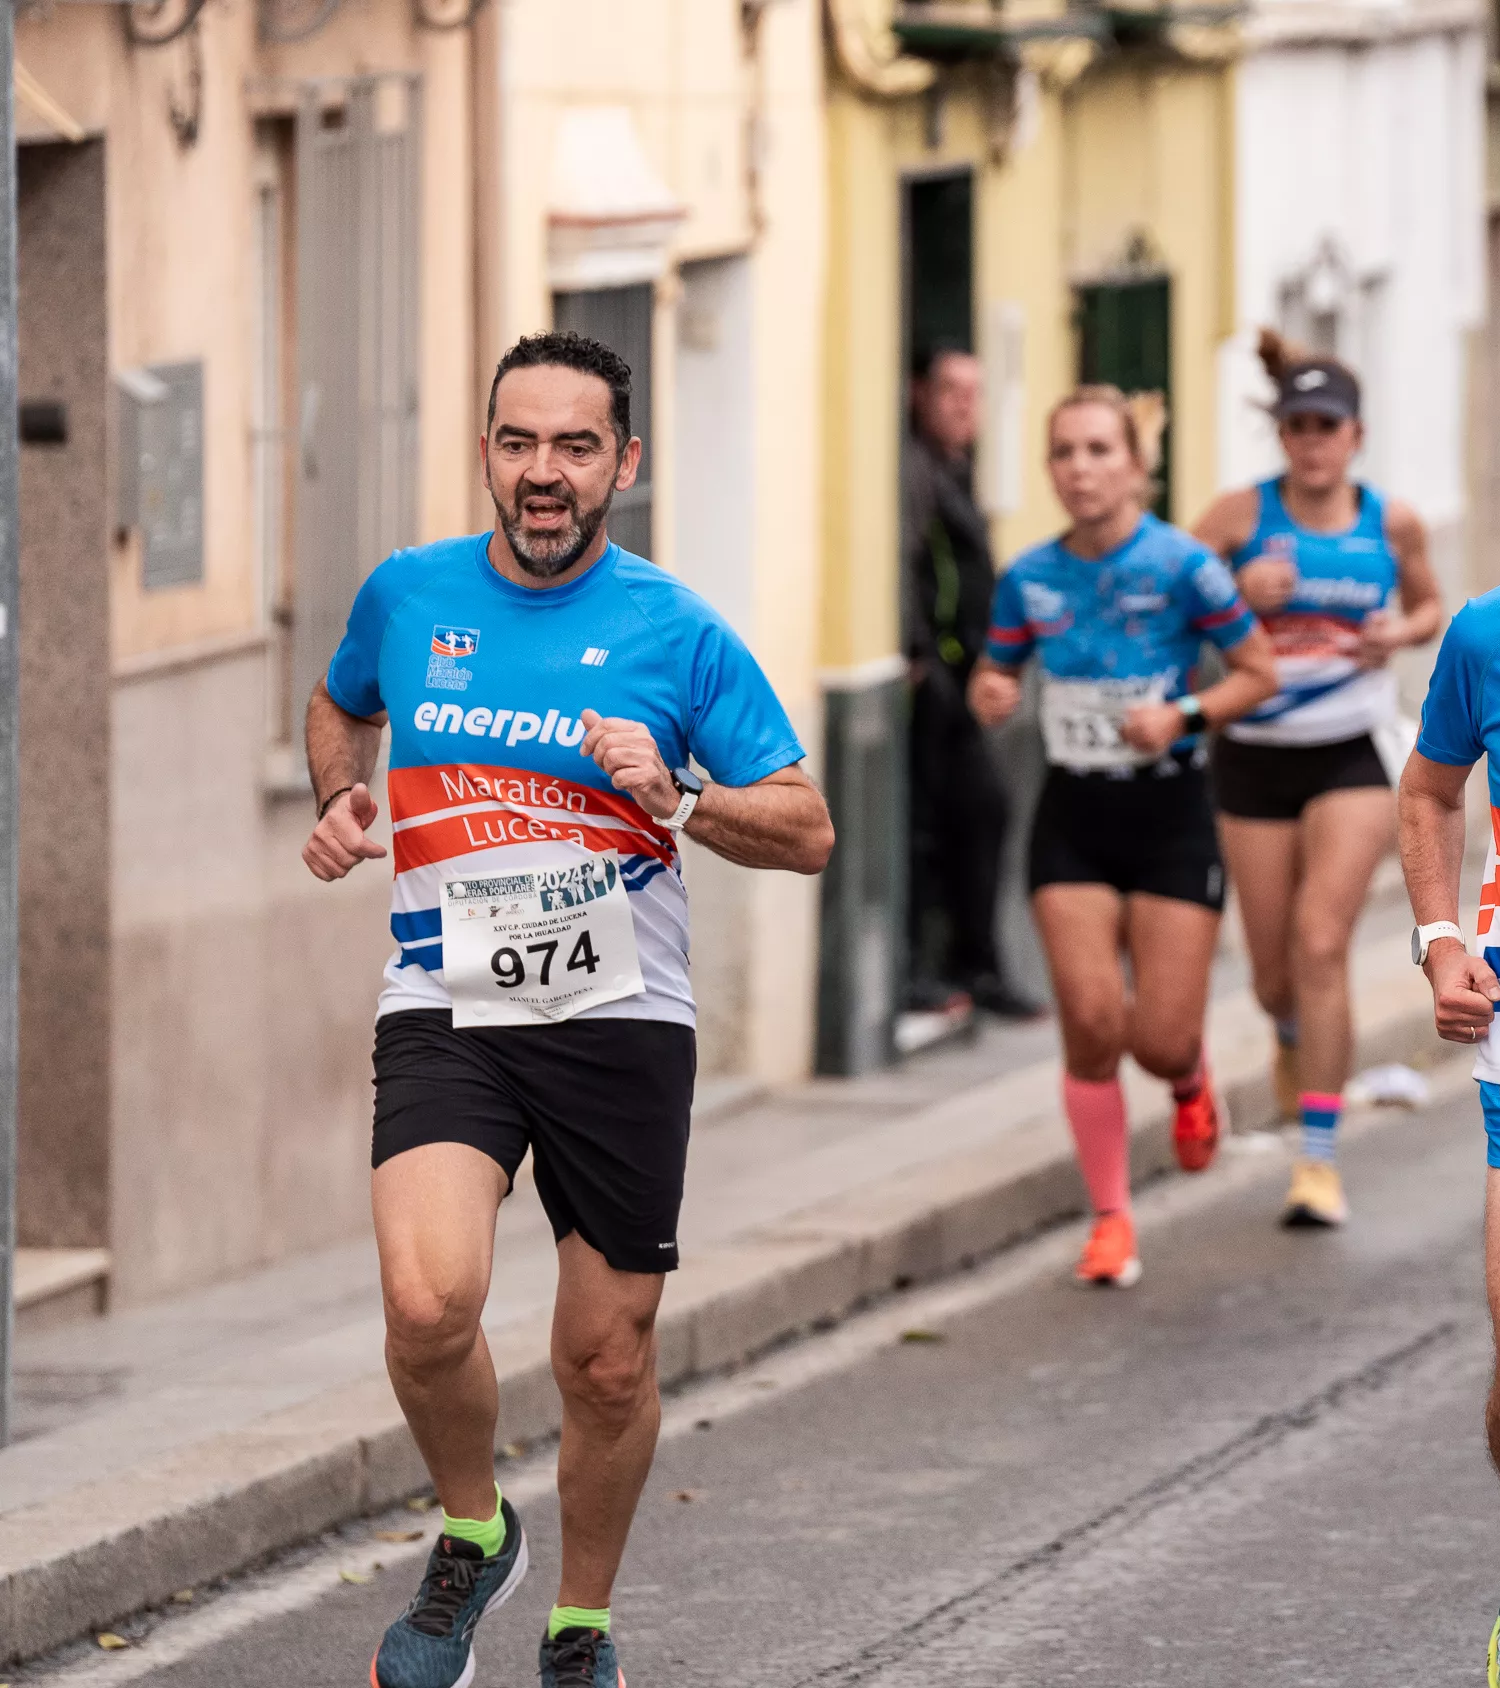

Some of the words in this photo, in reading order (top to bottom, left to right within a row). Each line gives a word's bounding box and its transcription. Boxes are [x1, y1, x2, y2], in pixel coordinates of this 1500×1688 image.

[429, 654, 456, 667] Club
[426, 677, 467, 691] Lucena
[414, 701, 586, 747] enerplu
[440, 769, 587, 812] Maratón
[480, 876, 521, 890] PROVINCIAL
[524, 874, 534, 885] DE
[489, 883, 535, 897] POPULARES
[521, 920, 548, 930] CIUDAD
[560, 911, 588, 923] LUCENA
[509, 932, 522, 941] POR
[534, 924, 572, 937] IGUALDAD
[491, 930, 601, 988] 974
